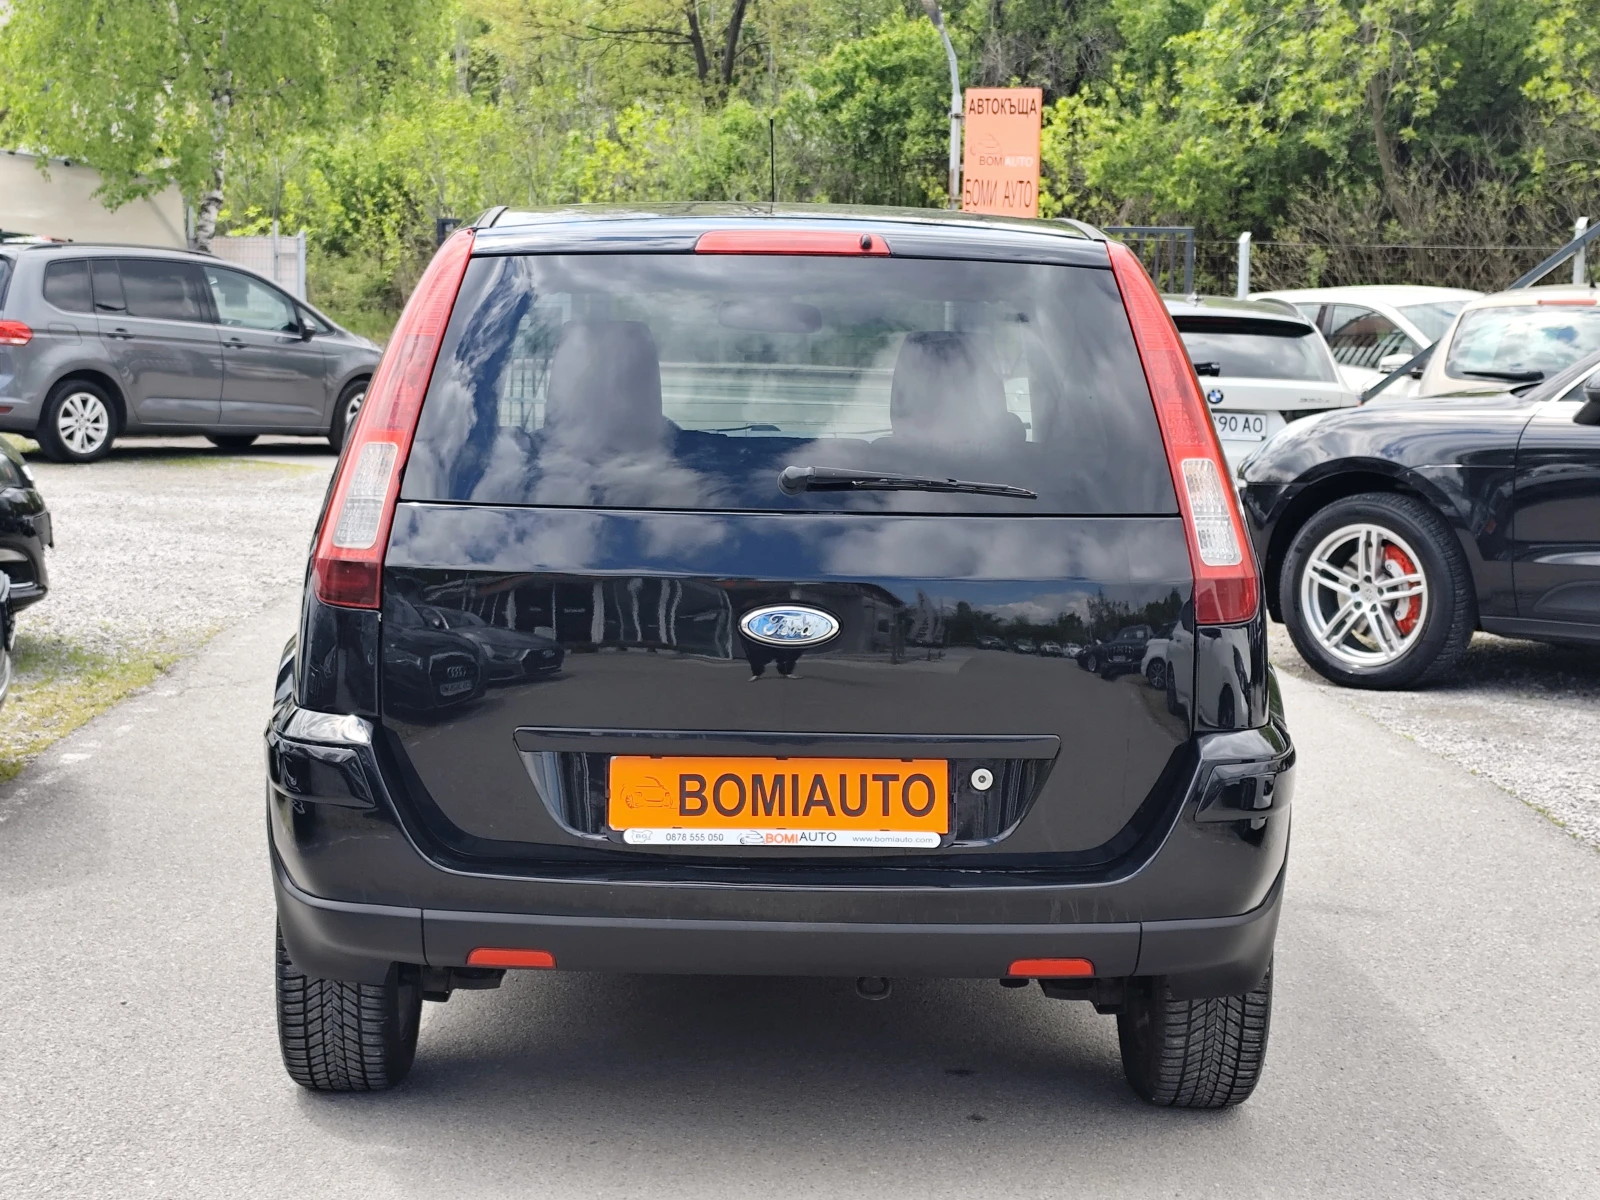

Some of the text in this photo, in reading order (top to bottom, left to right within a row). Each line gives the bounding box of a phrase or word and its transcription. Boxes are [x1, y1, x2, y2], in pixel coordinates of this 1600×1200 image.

[968, 97, 1038, 119] АВТОКЪЩА
[964, 178, 1033, 208] БОМИ АУТО
[1213, 416, 1238, 432] 90
[763, 614, 816, 637] Ford
[678, 773, 936, 817] BOMIAUTO
[665, 832, 724, 842] 0878 555 050
[852, 835, 934, 844] www.bomiauto.com
